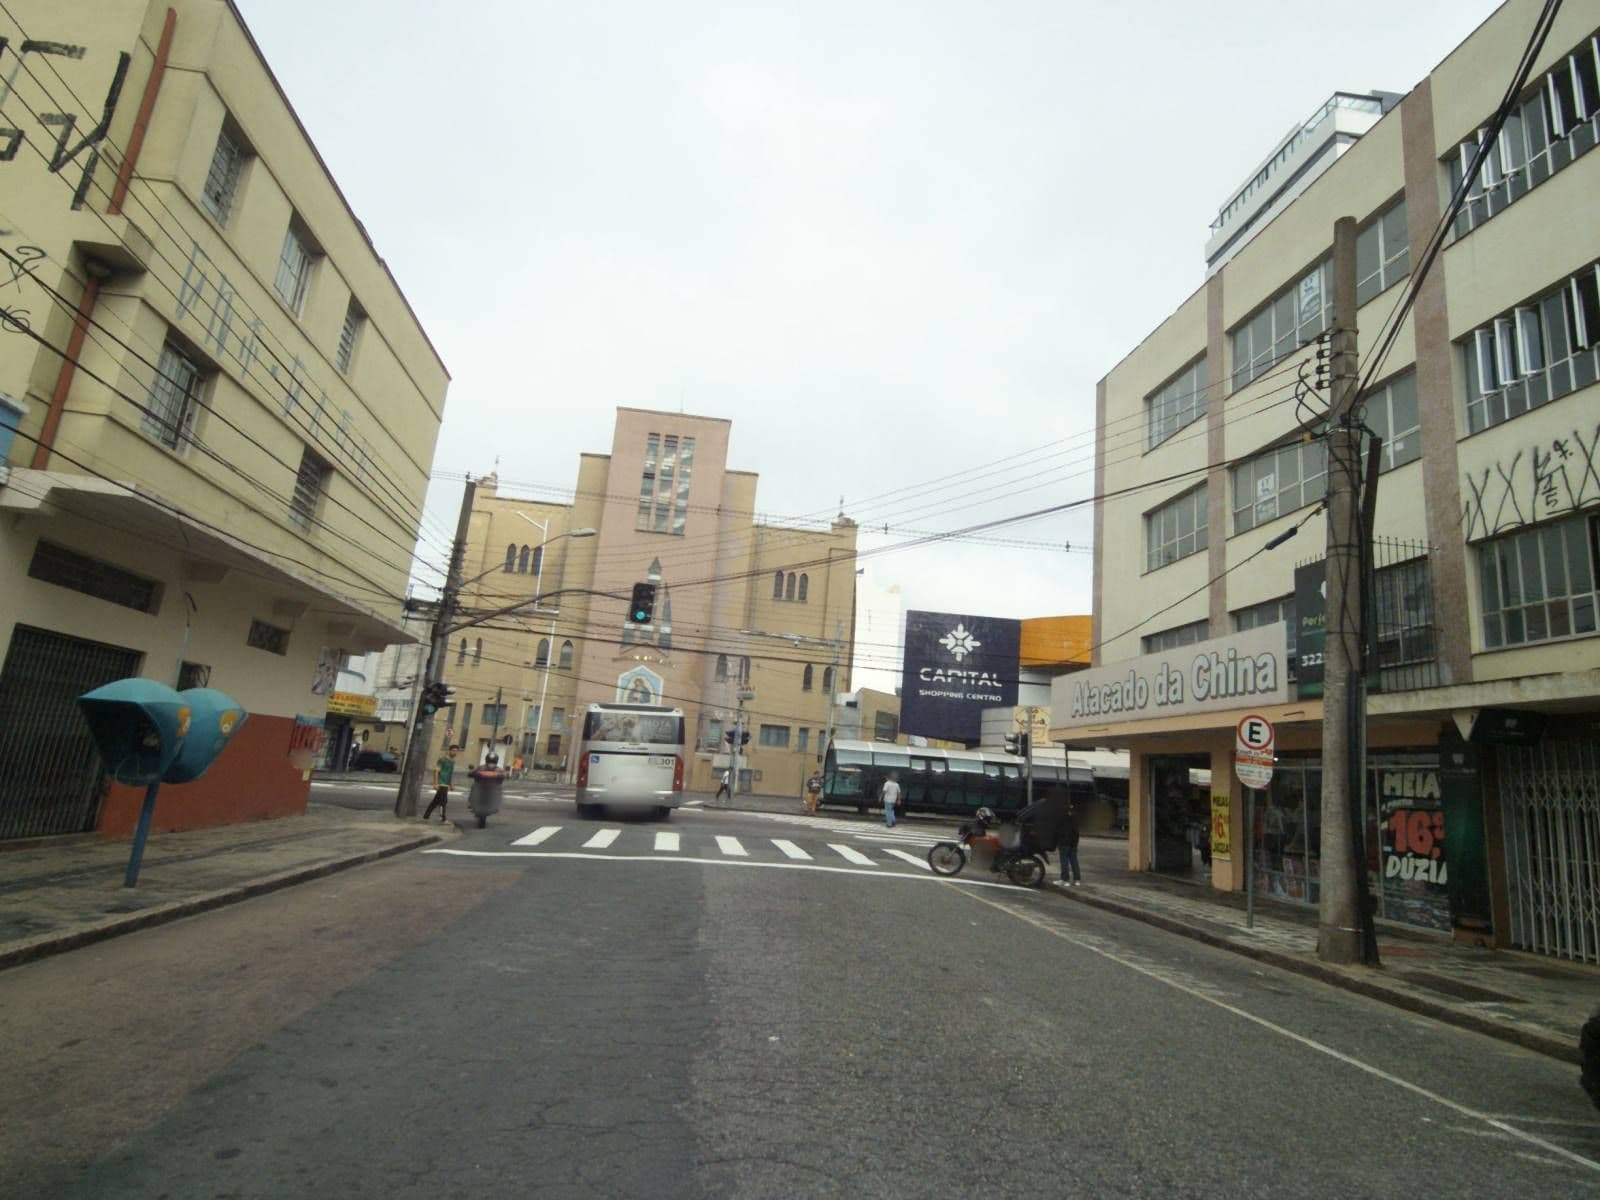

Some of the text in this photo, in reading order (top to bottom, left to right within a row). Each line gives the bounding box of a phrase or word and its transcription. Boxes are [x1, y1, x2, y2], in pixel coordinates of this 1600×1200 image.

[919, 667, 1003, 689] CAPITAL
[1072, 648, 1278, 717] Atacado da China
[918, 688, 1002, 702] SHOPPING CENTRO
[1248, 721, 1263, 744] E
